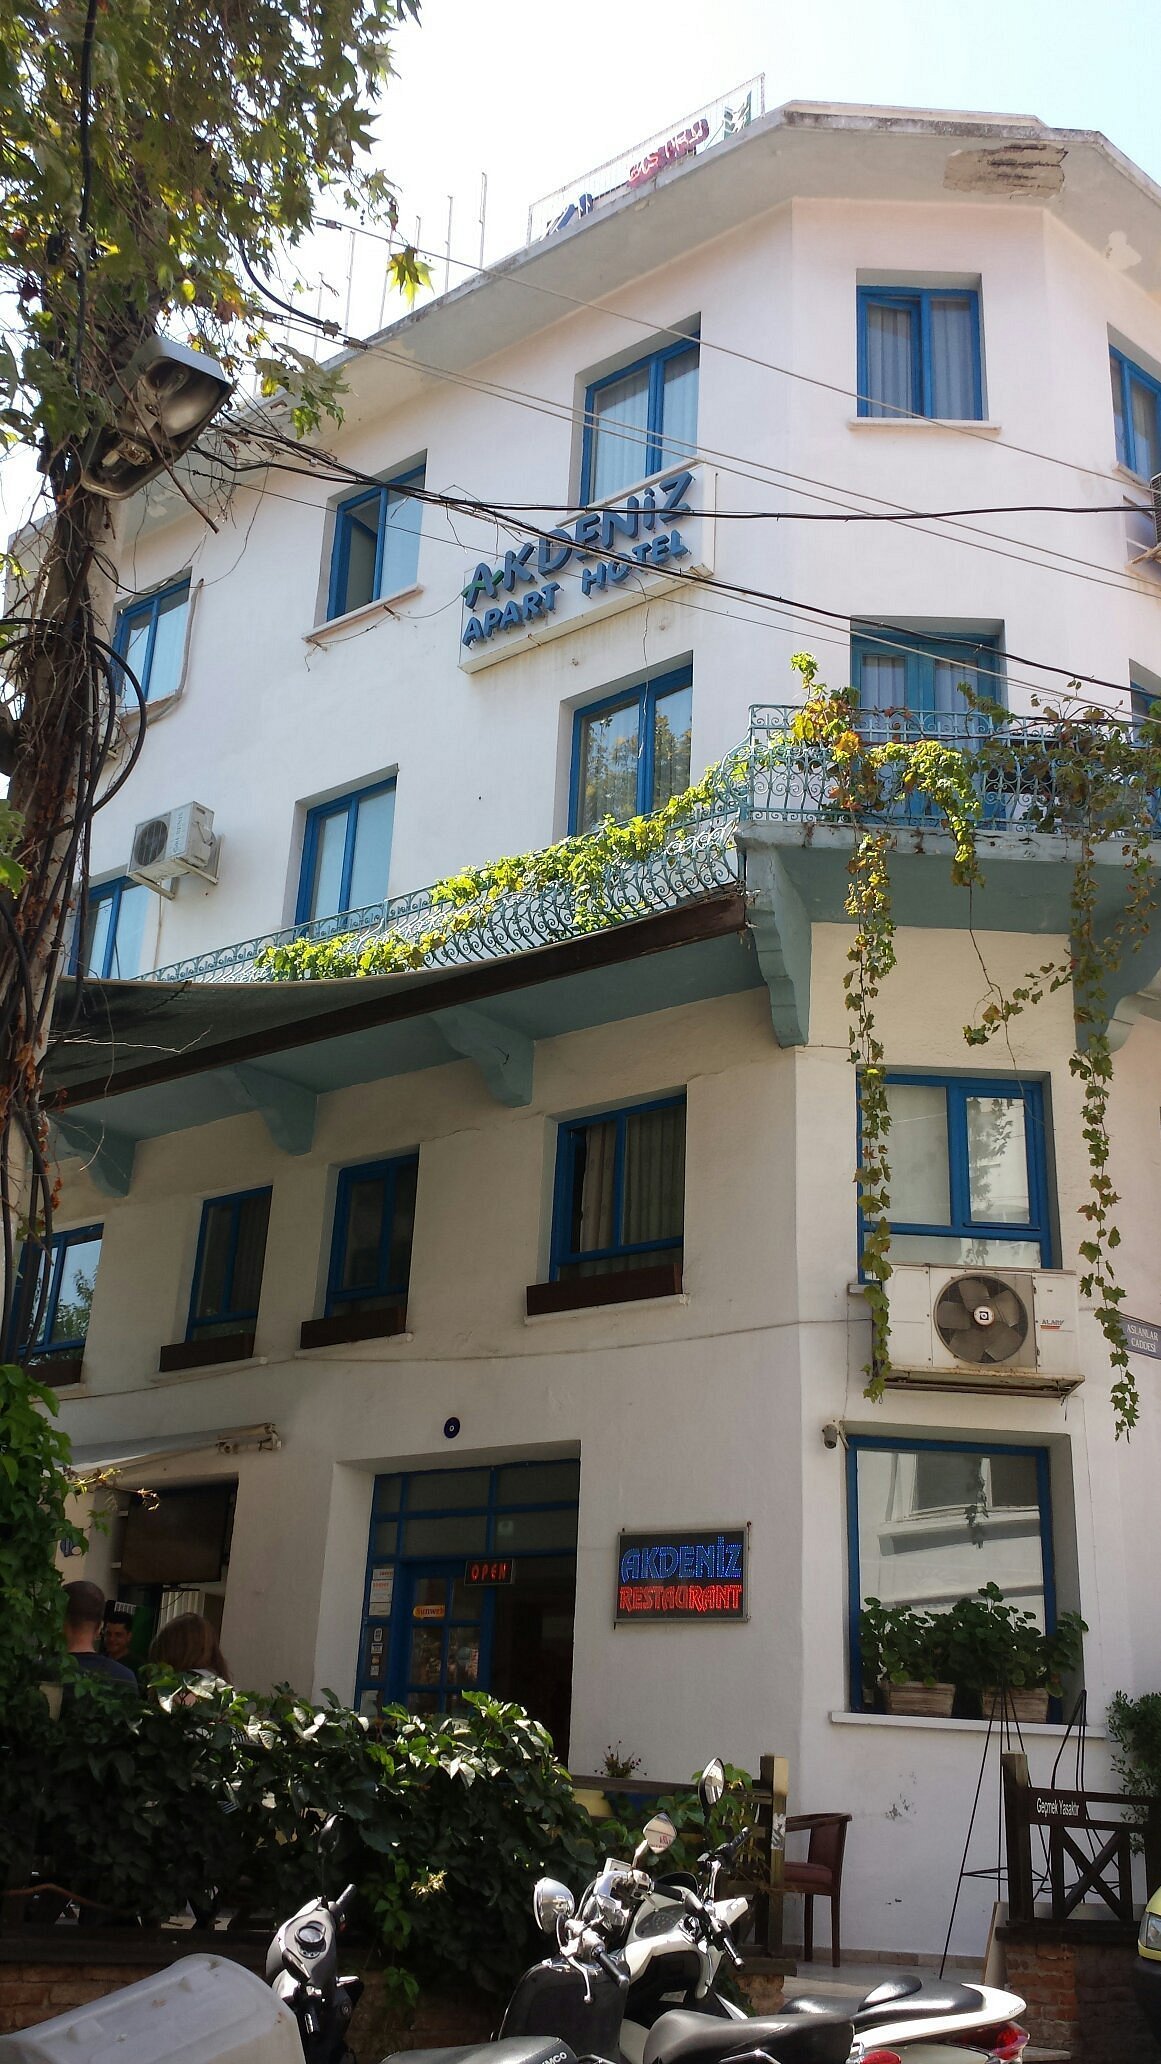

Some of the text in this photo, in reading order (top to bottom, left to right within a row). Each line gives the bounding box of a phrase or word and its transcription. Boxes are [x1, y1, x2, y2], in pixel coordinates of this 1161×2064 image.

[462, 529, 690, 647] APART HOTEL
[1126, 1324, 1159, 1341] ASLANLAR
[470, 1562, 508, 1582] OPEN
[620, 1584, 742, 1613] RESTAURANT
